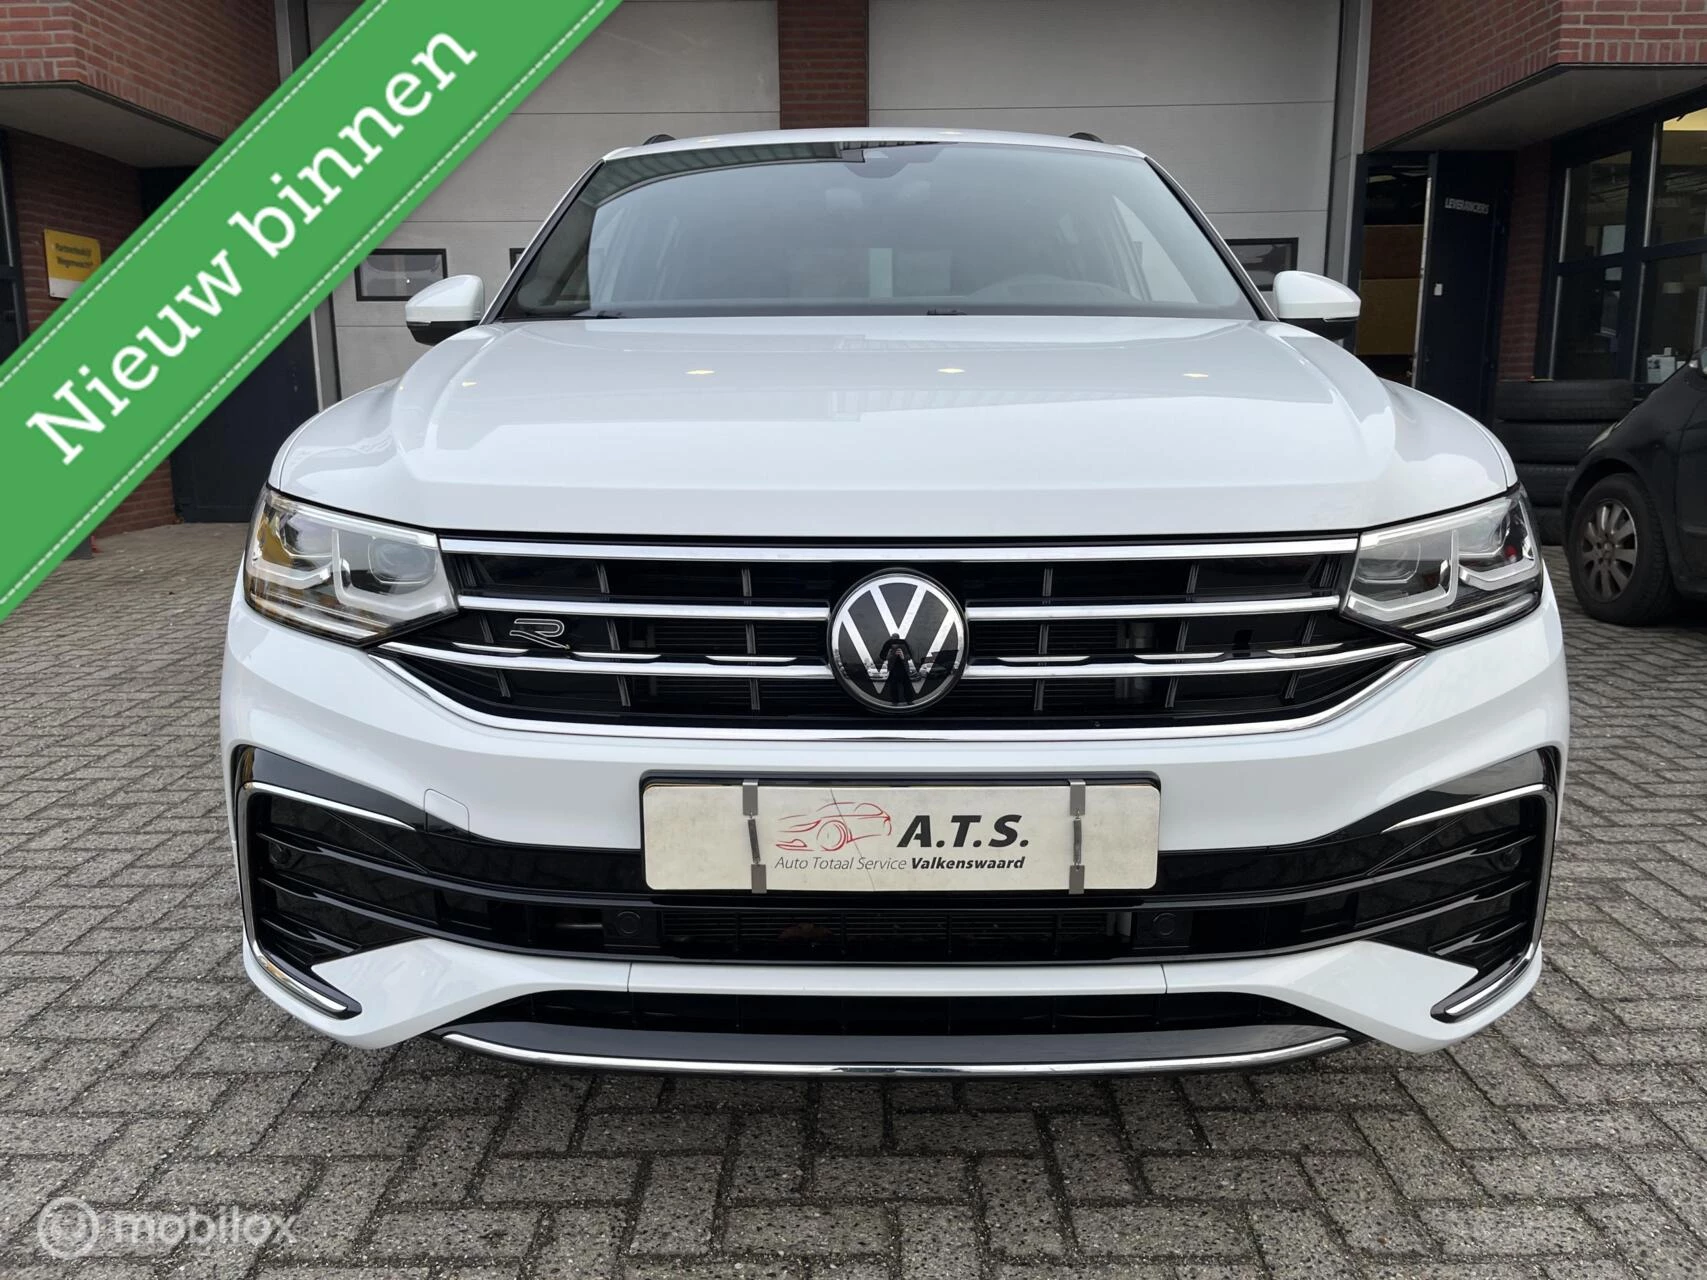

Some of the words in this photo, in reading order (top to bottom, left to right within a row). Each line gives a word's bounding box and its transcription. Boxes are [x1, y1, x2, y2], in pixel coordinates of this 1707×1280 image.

[896, 814, 1030, 849] A.T.S.
[774, 856, 808, 870] Auto
[812, 856, 852, 870] Totaal
[856, 856, 907, 870] Service
[911, 856, 1025, 870] Valkenswaard
